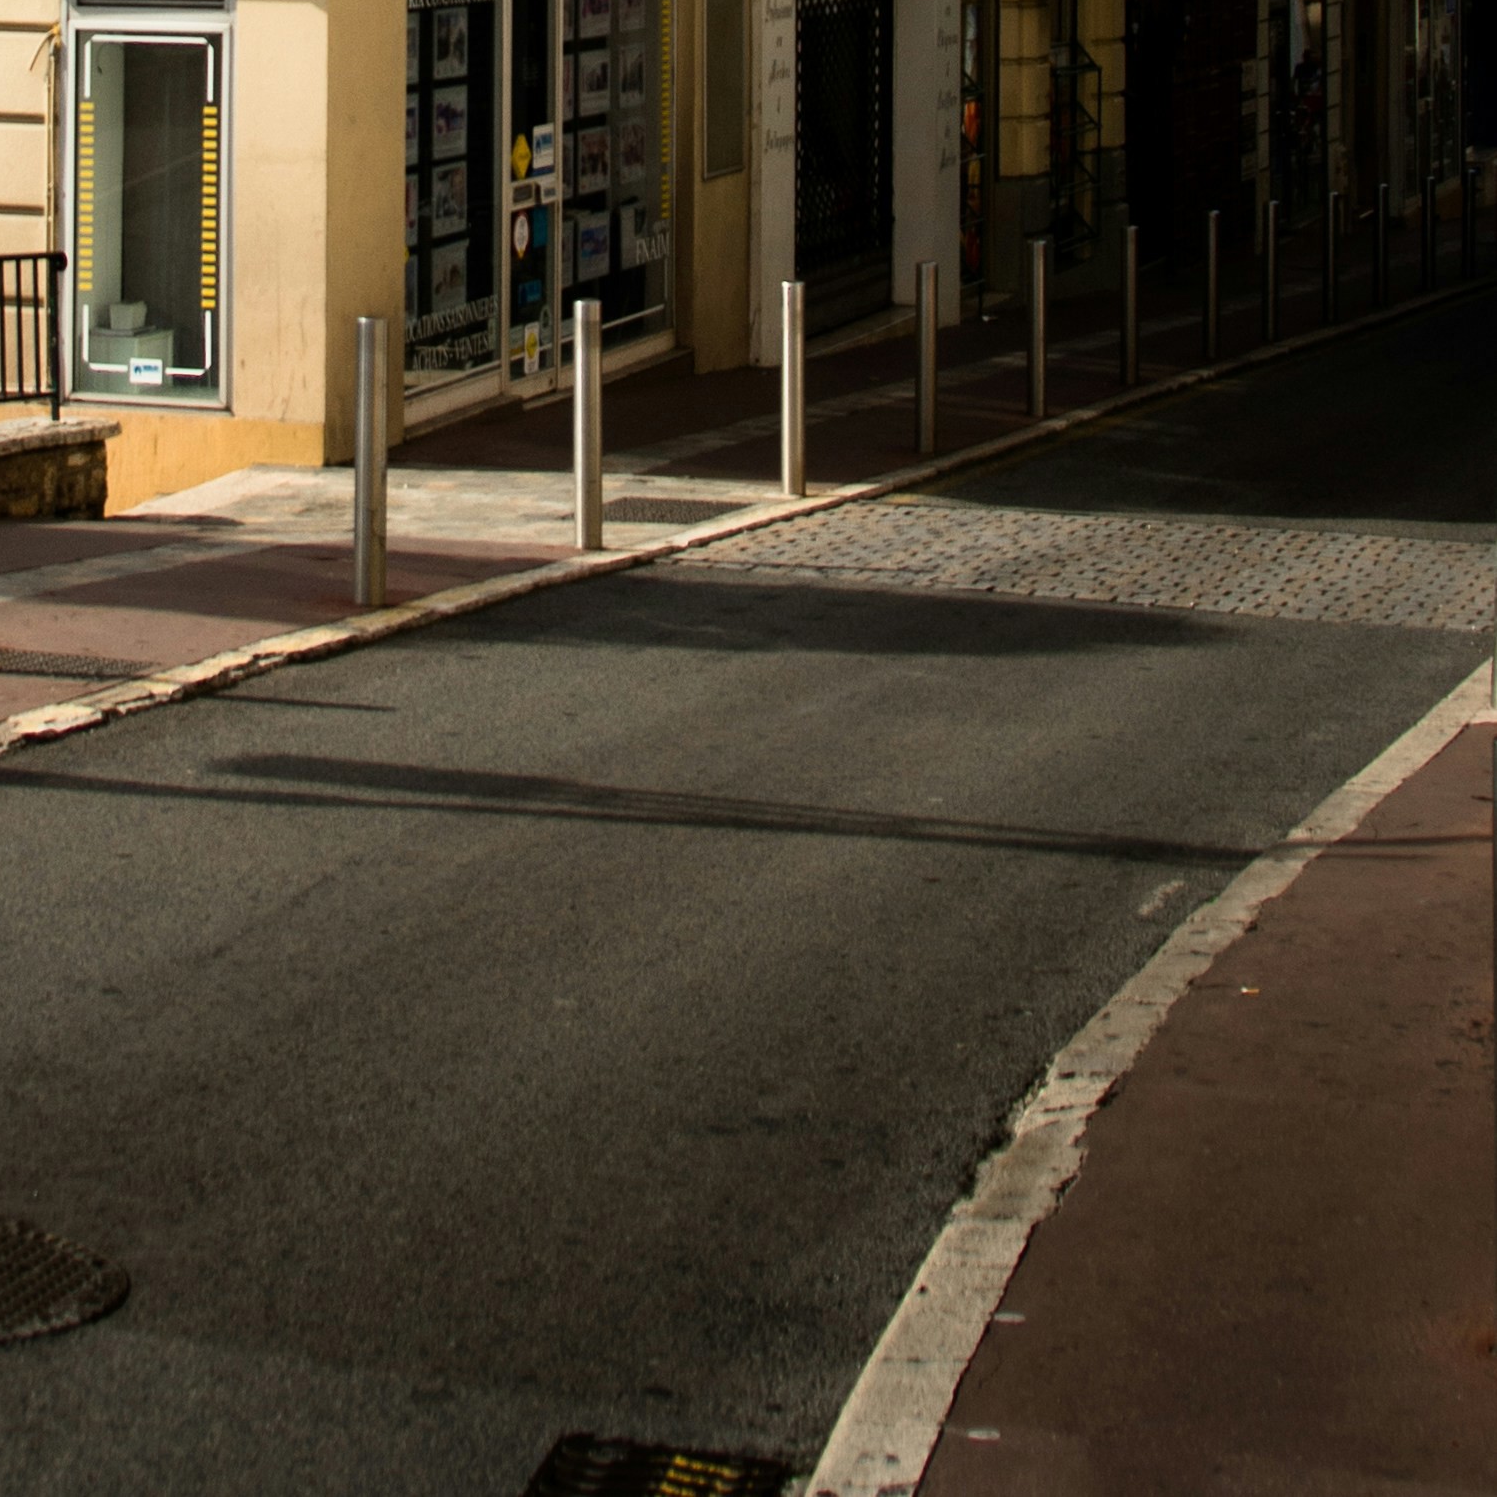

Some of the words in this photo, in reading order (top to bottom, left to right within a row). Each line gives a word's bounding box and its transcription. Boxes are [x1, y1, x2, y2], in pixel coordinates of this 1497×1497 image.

[635, 232, 670, 265] FNAIM
[412, 346, 448, 372] ACHATS
[454, 330, 489, 361] VENTES
